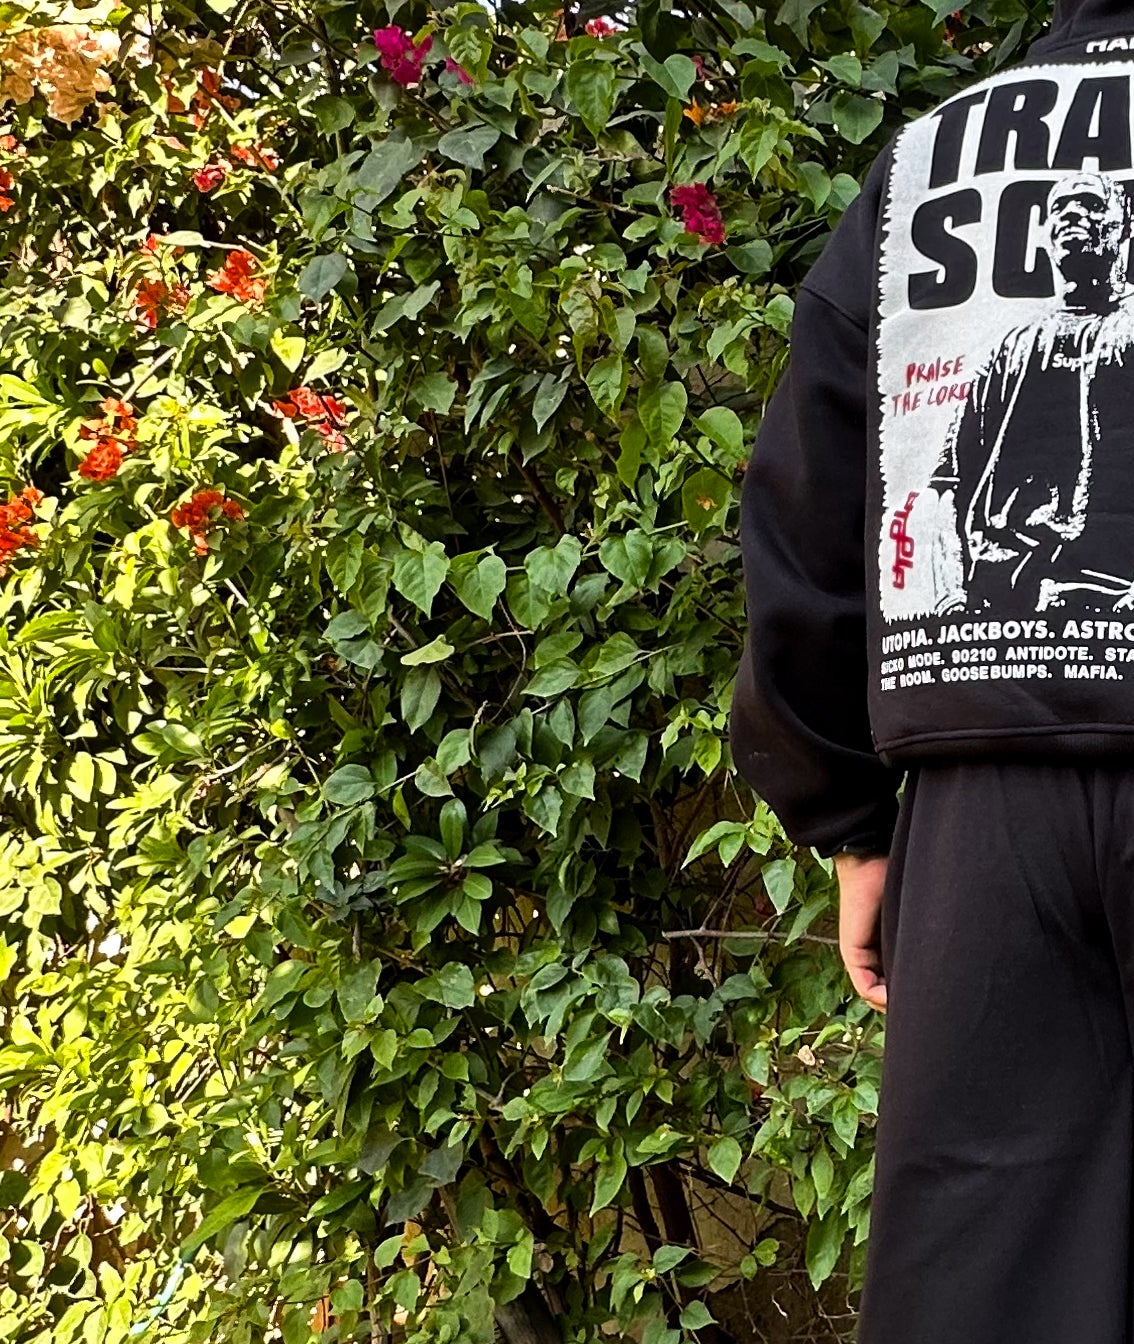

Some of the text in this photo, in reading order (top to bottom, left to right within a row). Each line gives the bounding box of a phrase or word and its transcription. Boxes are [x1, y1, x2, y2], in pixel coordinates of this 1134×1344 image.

[906, 354, 966, 388] PRAISE
[891, 381, 972, 418] THE LORD
[881, 628, 933, 654] UTOPIA.
[937, 620, 1056, 644] JACKBOYS.
[908, 652, 945, 668] MODE.
[951, 648, 997, 664] 90210
[1005, 646, 1094, 661] ANTIDOTE.
[880, 677, 896, 691] THE
[900, 670, 936, 688] ROOM.
[941, 664, 1052, 682] GOOSEBUMPS.
[1064, 664, 1124, 680] MAFIA.
